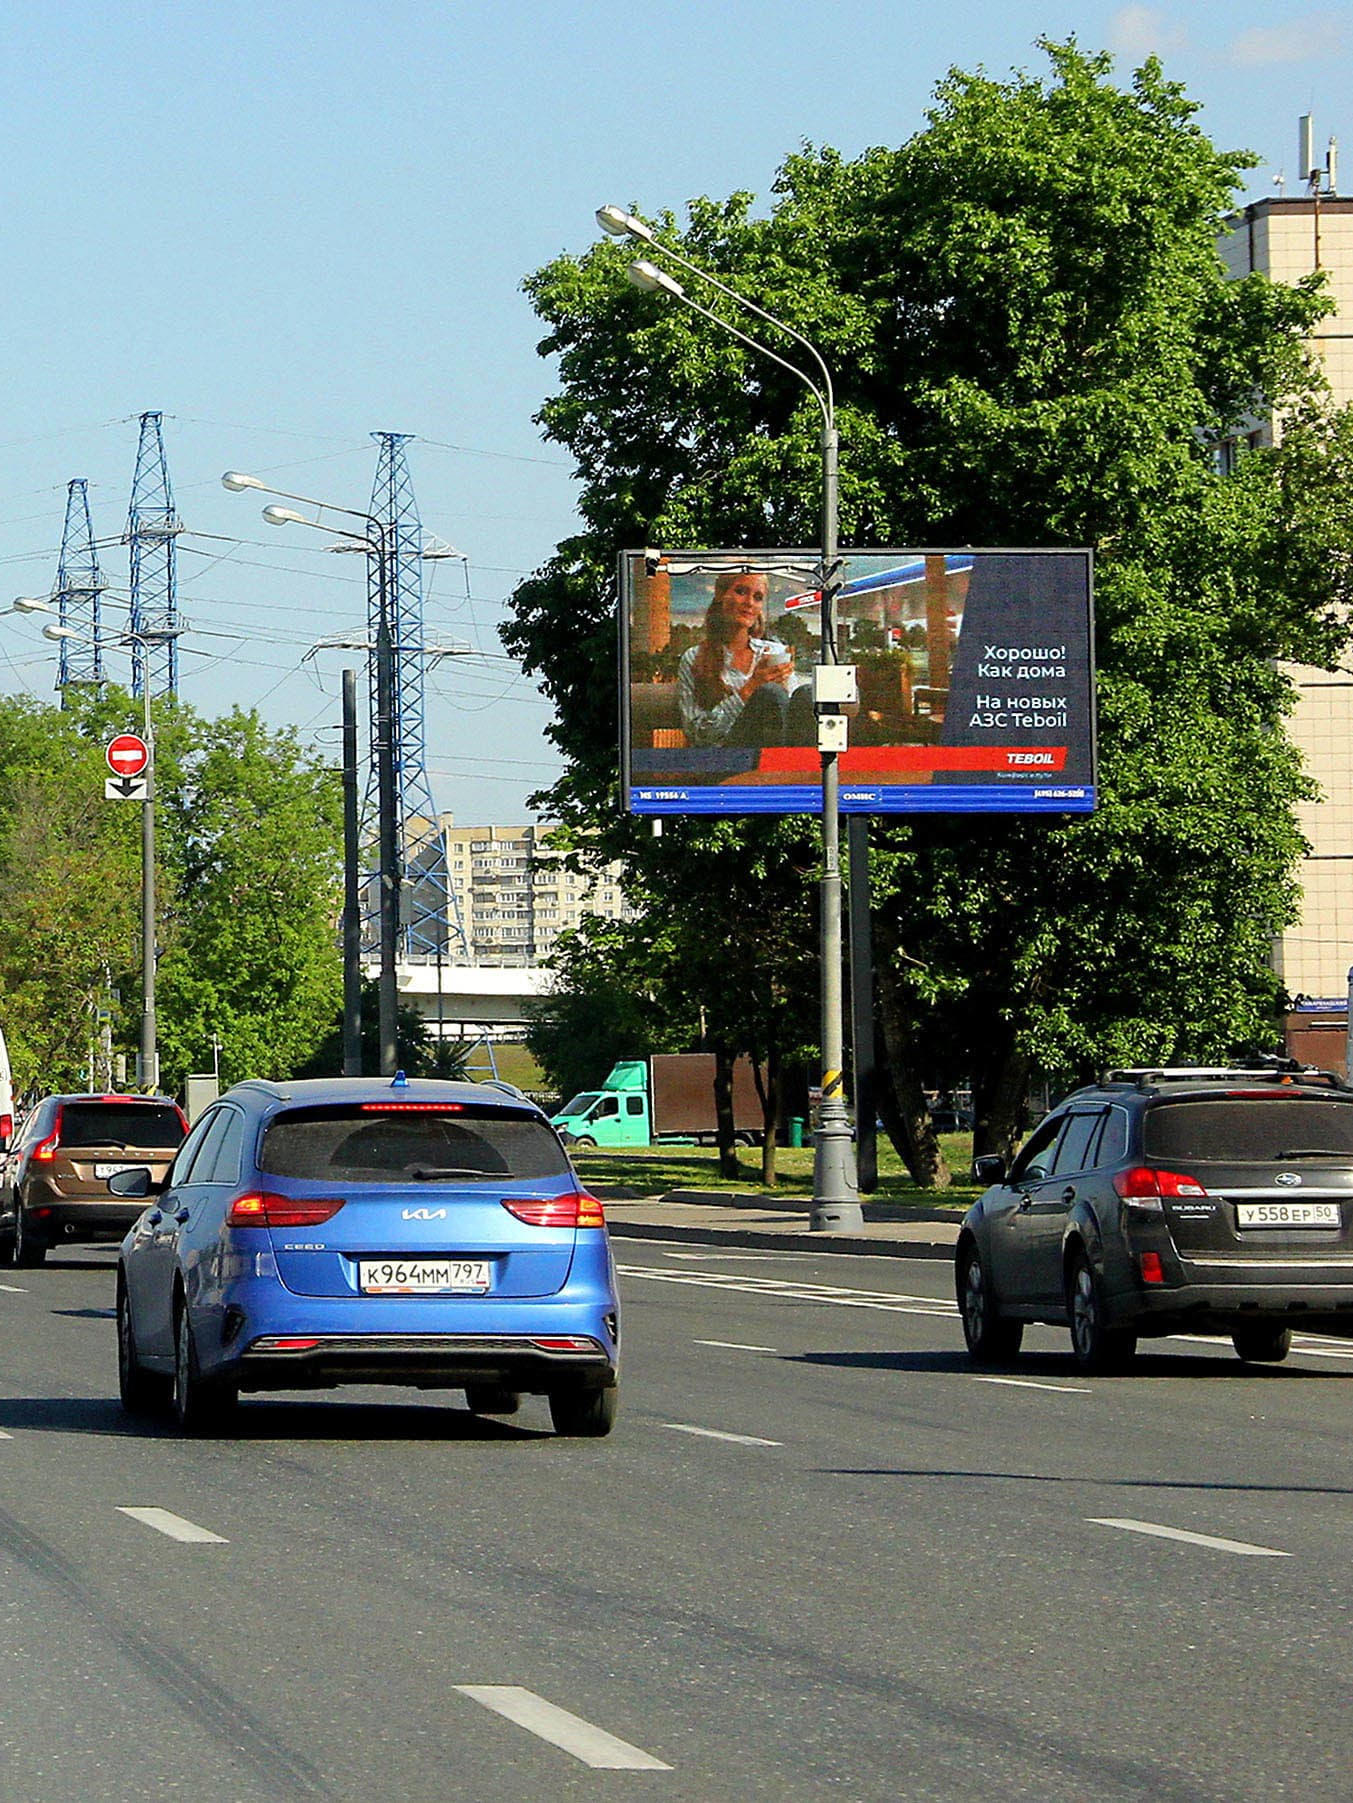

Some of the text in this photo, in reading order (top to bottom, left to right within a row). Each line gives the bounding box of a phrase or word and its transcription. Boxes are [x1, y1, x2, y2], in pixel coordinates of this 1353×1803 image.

[984, 645, 1066, 662] Хорошо!
[978, 664, 1066, 680] Как дома
[976, 695, 1068, 710] На новых
[969, 712, 1068, 728] АЗС Teboil
[1006, 753, 1055, 765] TEBOIL
[1316, 1205, 1332, 1218] 50
[367, 1263, 484, 1284] К964ММ 797
